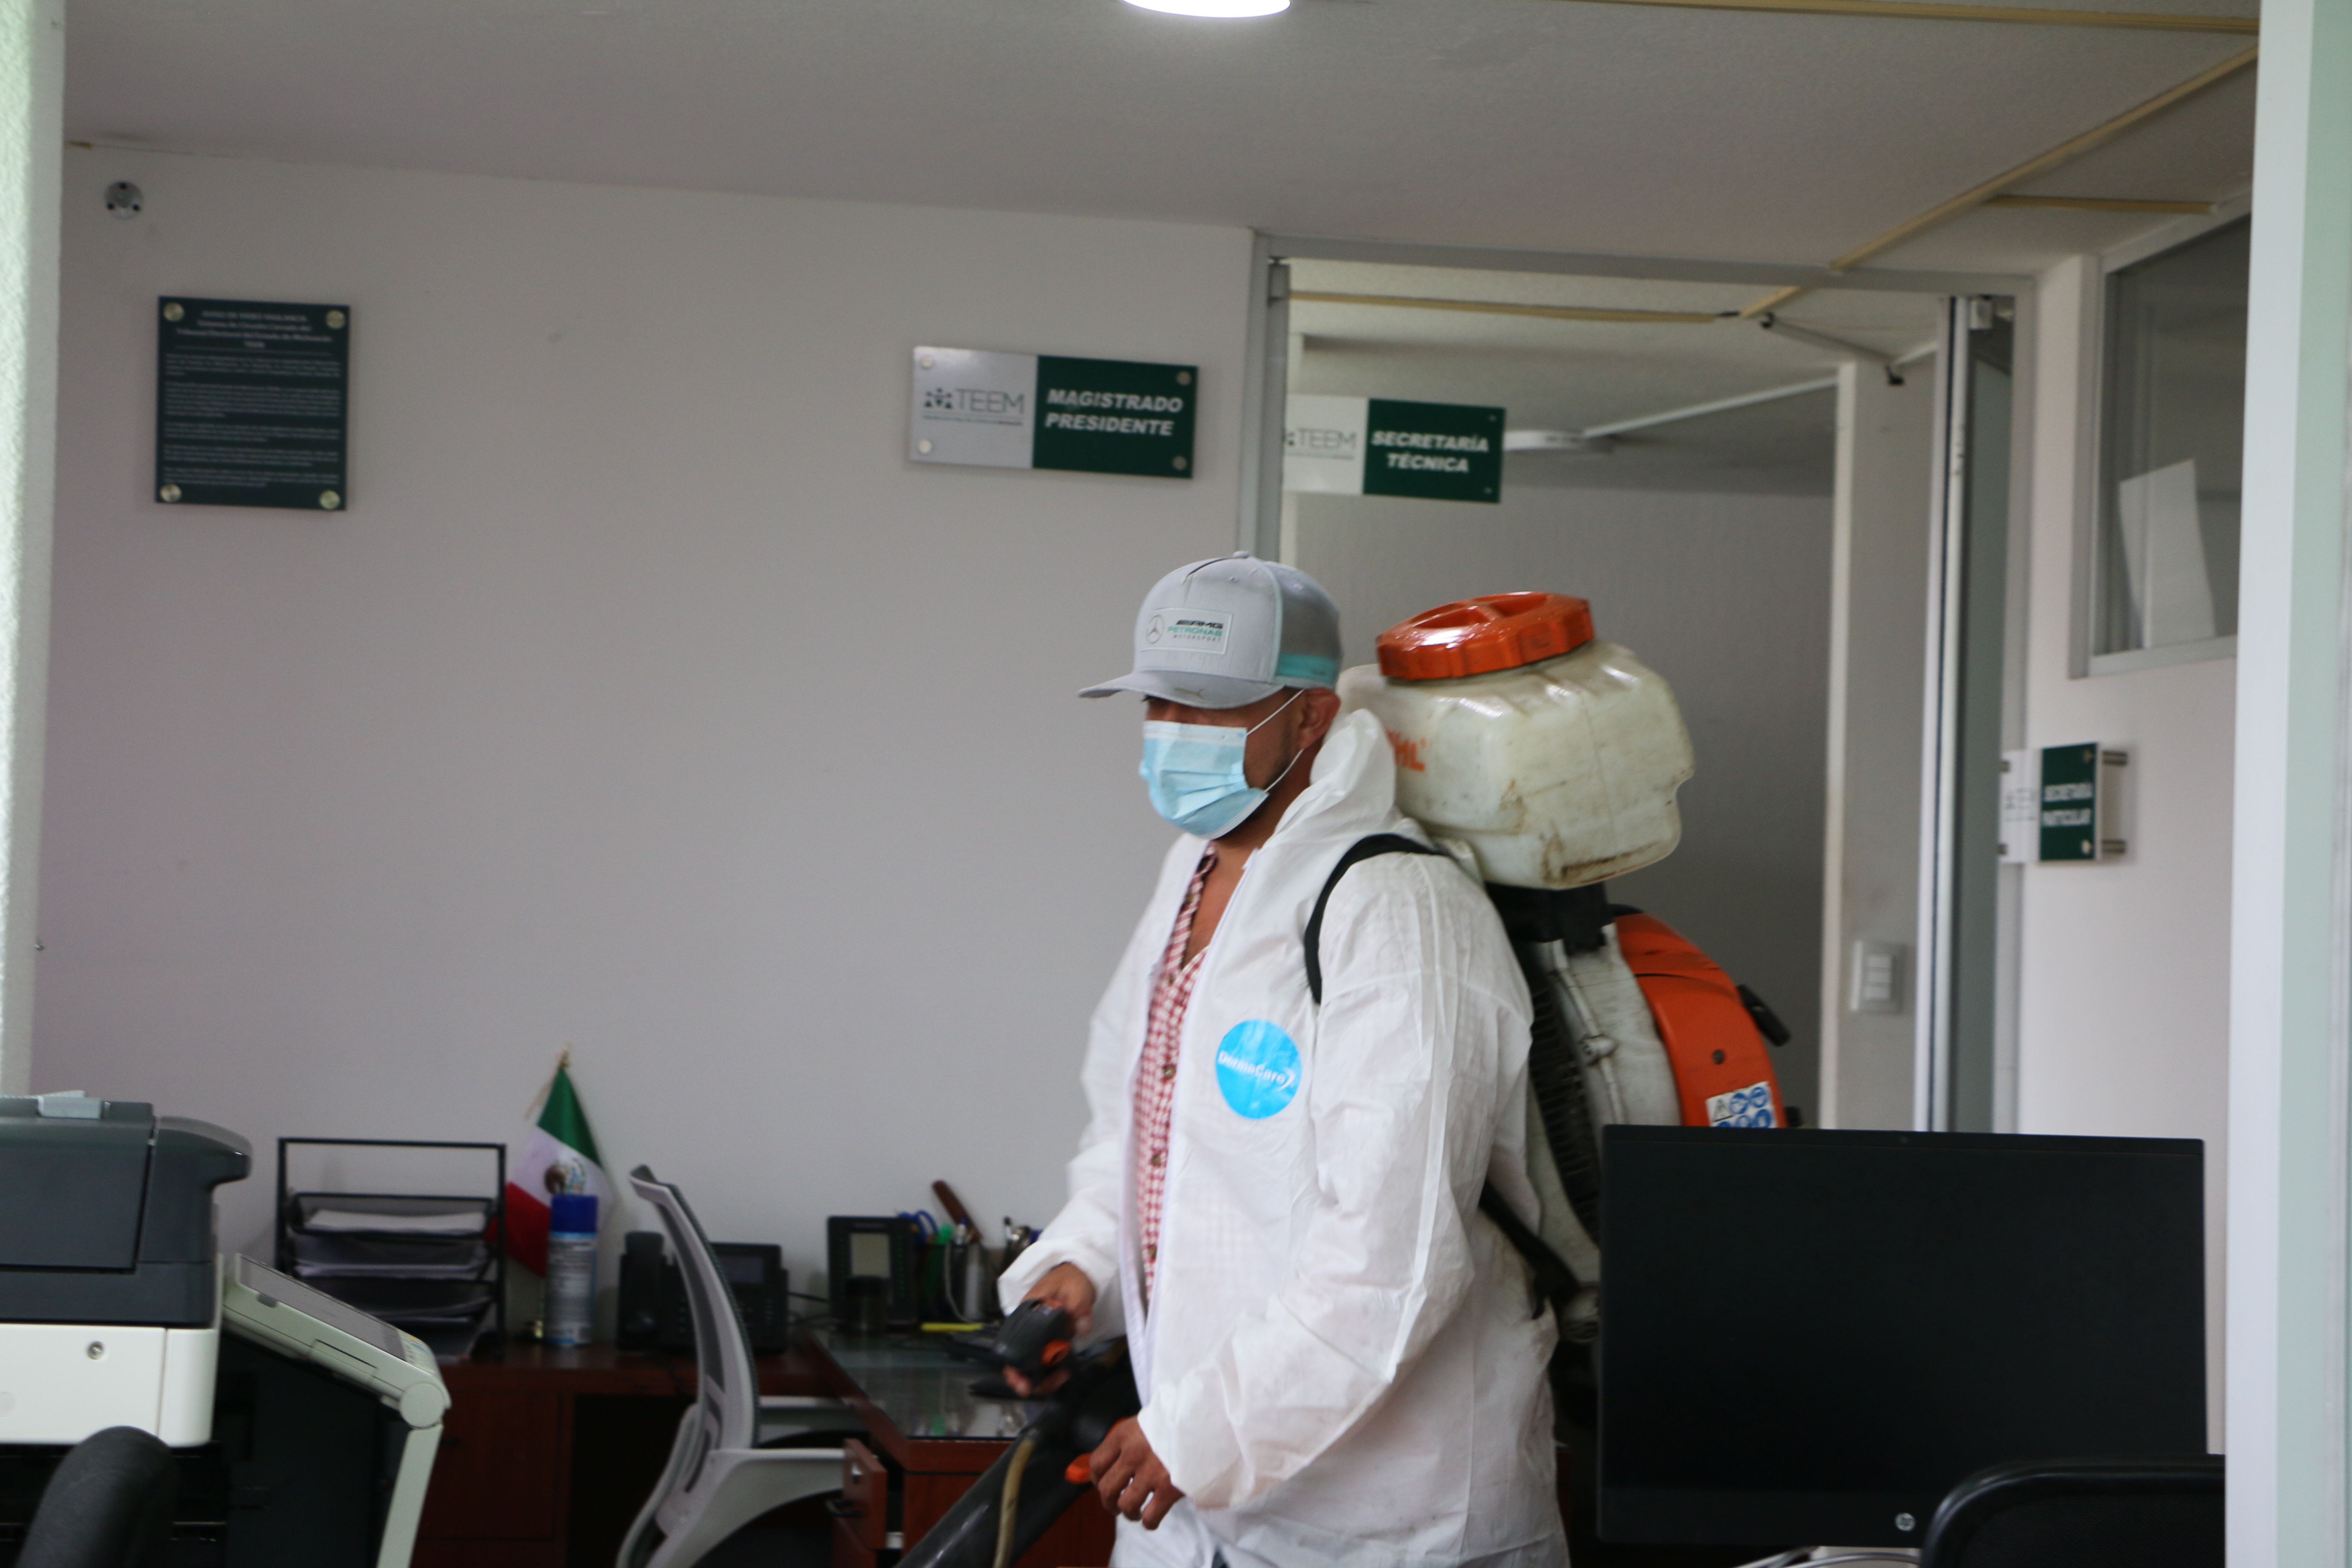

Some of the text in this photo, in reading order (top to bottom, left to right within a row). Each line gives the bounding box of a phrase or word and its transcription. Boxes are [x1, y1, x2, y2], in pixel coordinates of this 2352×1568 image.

[956, 388, 1024, 414] TEEM
[1047, 388, 1184, 413] MAGISTRADO
[1045, 412, 1174, 436] PRESIDENTE
[1297, 428, 1357, 449] TEEM
[1372, 431, 1488, 453] SECRETARÍA
[1387, 451, 1469, 472] TÉCNICA
[1168, 626, 1222, 636] PETRONAS
